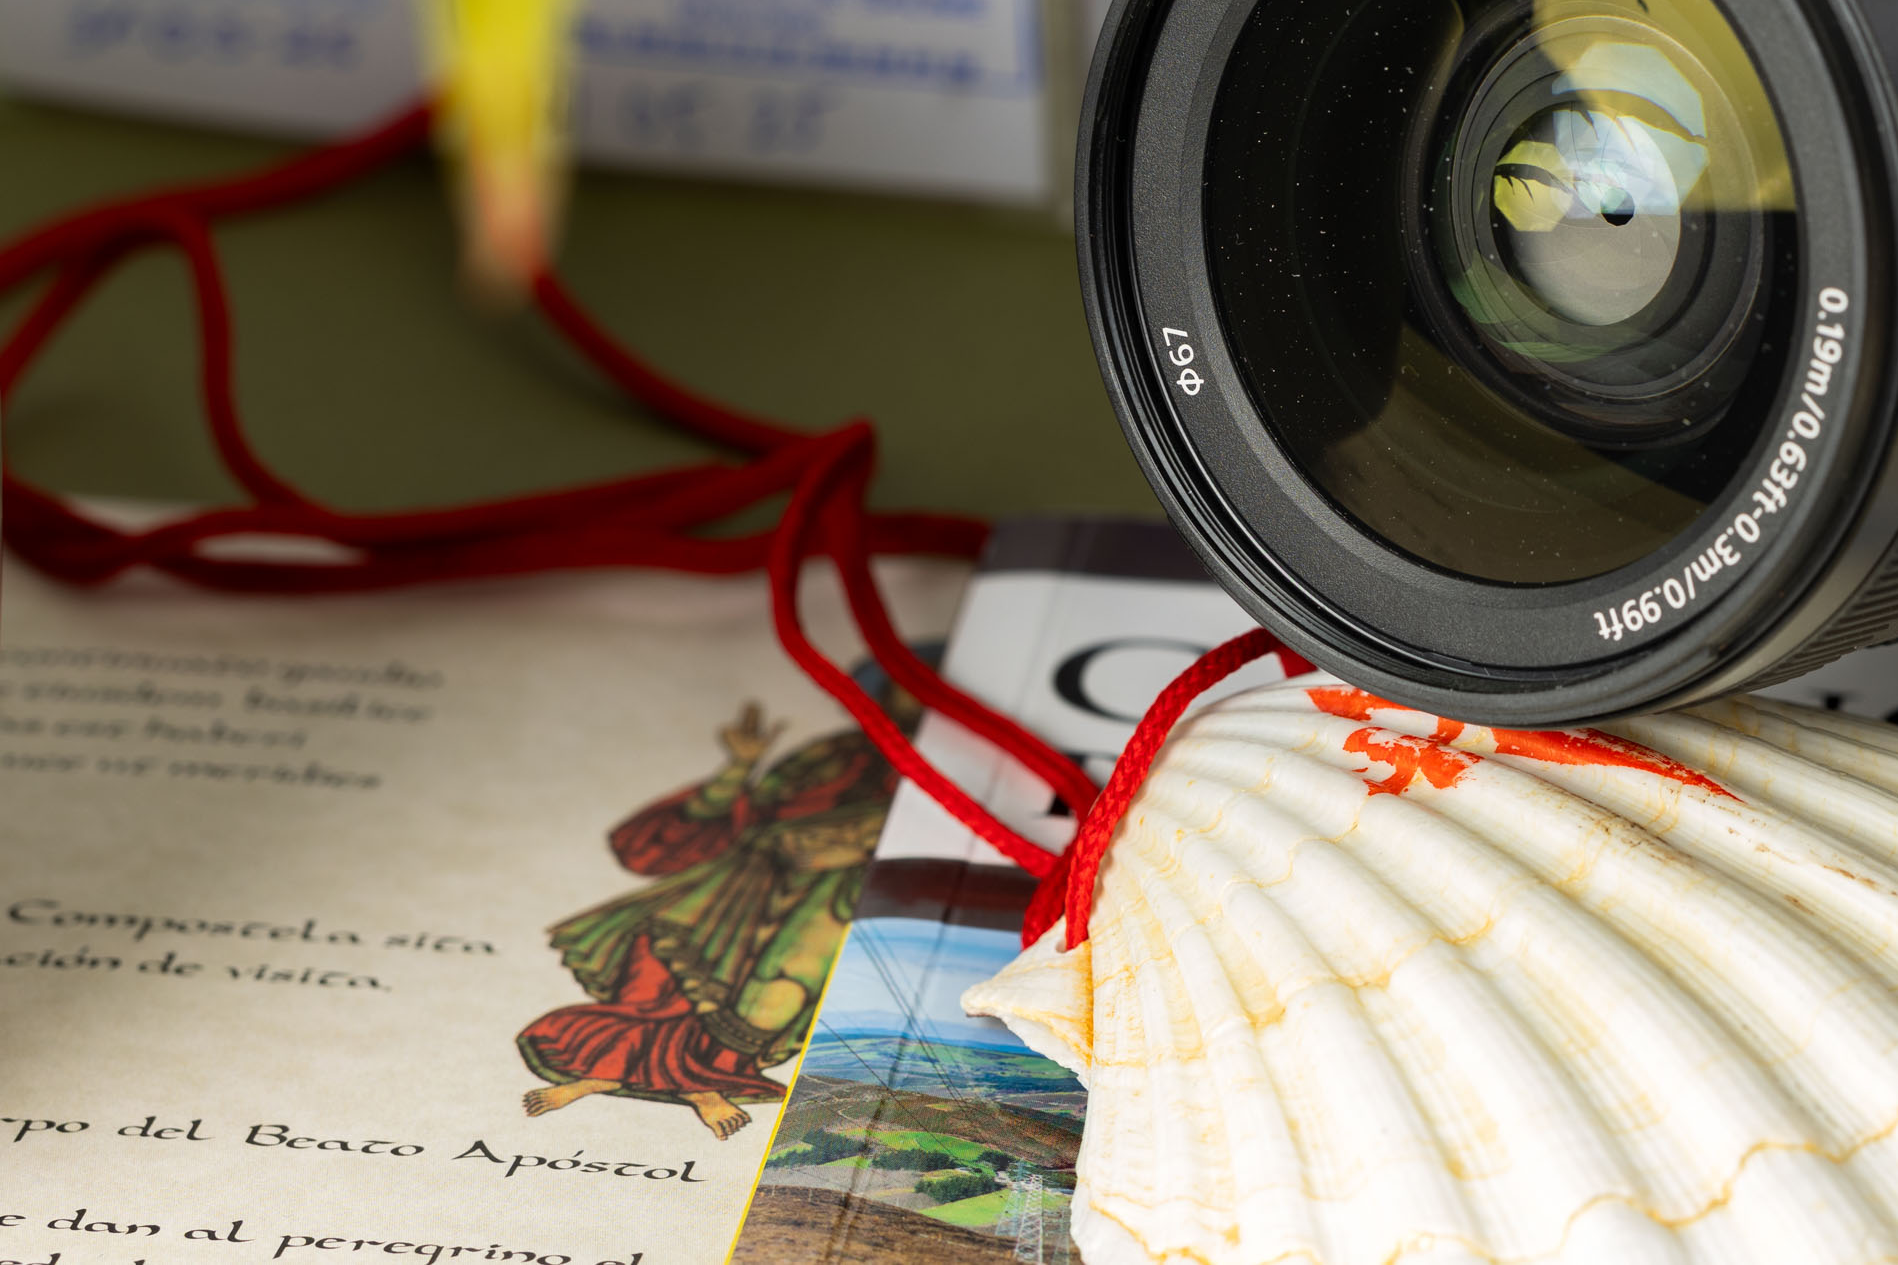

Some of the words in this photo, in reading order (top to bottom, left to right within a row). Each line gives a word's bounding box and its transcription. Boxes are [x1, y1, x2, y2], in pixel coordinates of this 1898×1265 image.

[1593, 286, 1849, 642] 0.19m/0.63ft-0.3m/0.99ft
[138, 951, 205, 978] de
[117, 1116, 216, 1142] del
[245, 1124, 426, 1159] Beato
[453, 1139, 710, 1184] Apóstol
[47, 1208, 161, 1236] dan
[184, 1220, 255, 1243] al
[272, 1234, 572, 1265] peregrino
